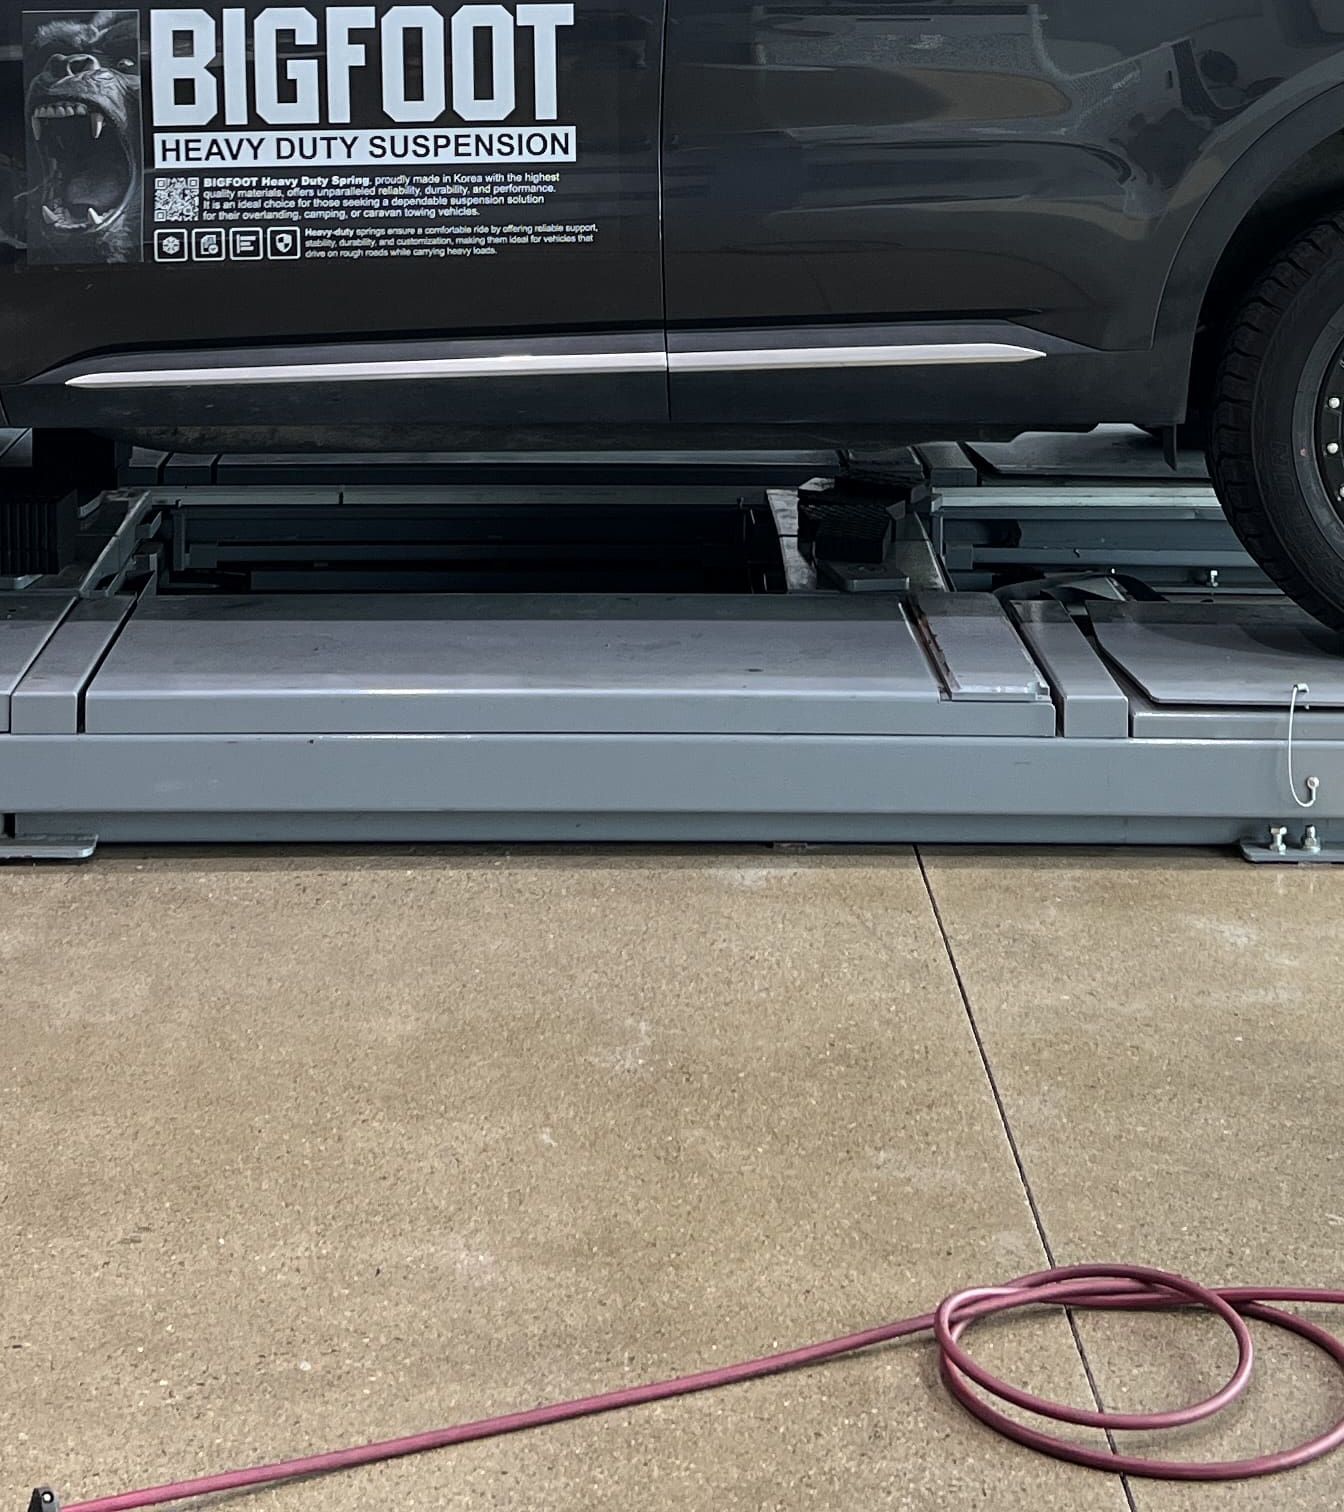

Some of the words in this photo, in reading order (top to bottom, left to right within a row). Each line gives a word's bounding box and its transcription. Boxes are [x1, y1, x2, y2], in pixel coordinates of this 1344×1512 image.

[150, 3, 575, 127] BIGFOOT
[161, 137, 266, 163] HEAVY
[275, 135, 357, 161] DUTY
[368, 131, 571, 160] SUSPENSION
[203, 177, 258, 187] BIGFOOT
[261, 176, 298, 188] Heavy
[300, 175, 329, 188] Duty
[374, 174, 410, 187] proudly
[412, 173, 440, 184] made
[442, 173, 452, 184] in
[454, 173, 483, 183] Korea
[485, 172, 505, 183] with
[507, 172, 523, 182] the
[524, 172, 560, 184] highest
[203, 188, 235, 200] quality
[237, 188, 284, 199] materials,
[286, 187, 315, 197] offers
[316, 186, 376, 198] unparalleled
[378, 185, 422, 197] reliability,
[425, 185, 470, 196] durability,
[472, 184, 491, 194] and
[493, 184, 557, 195] performance.
[203, 199, 211, 209] It
[212, 199, 222, 209] is
[223, 200, 236, 209] an
[237, 199, 262, 209] ideal
[263, 198, 296, 208] choice
[297, 198, 311, 208] for
[313, 198, 341, 208] those
[342, 197, 381, 209] seeking
[391, 196, 448, 207] dependable
[450, 195, 505, 206] suspension
[507, 194, 545, 205] solution
[203, 211, 216, 221] for
[218, 210, 241, 220] their
[304, 210, 349, 221] camping,
[350, 209, 361, 218] or
[363, 208, 403, 218] caravan
[404, 207, 436, 219] towing
[438, 207, 481, 217] vehicles.
